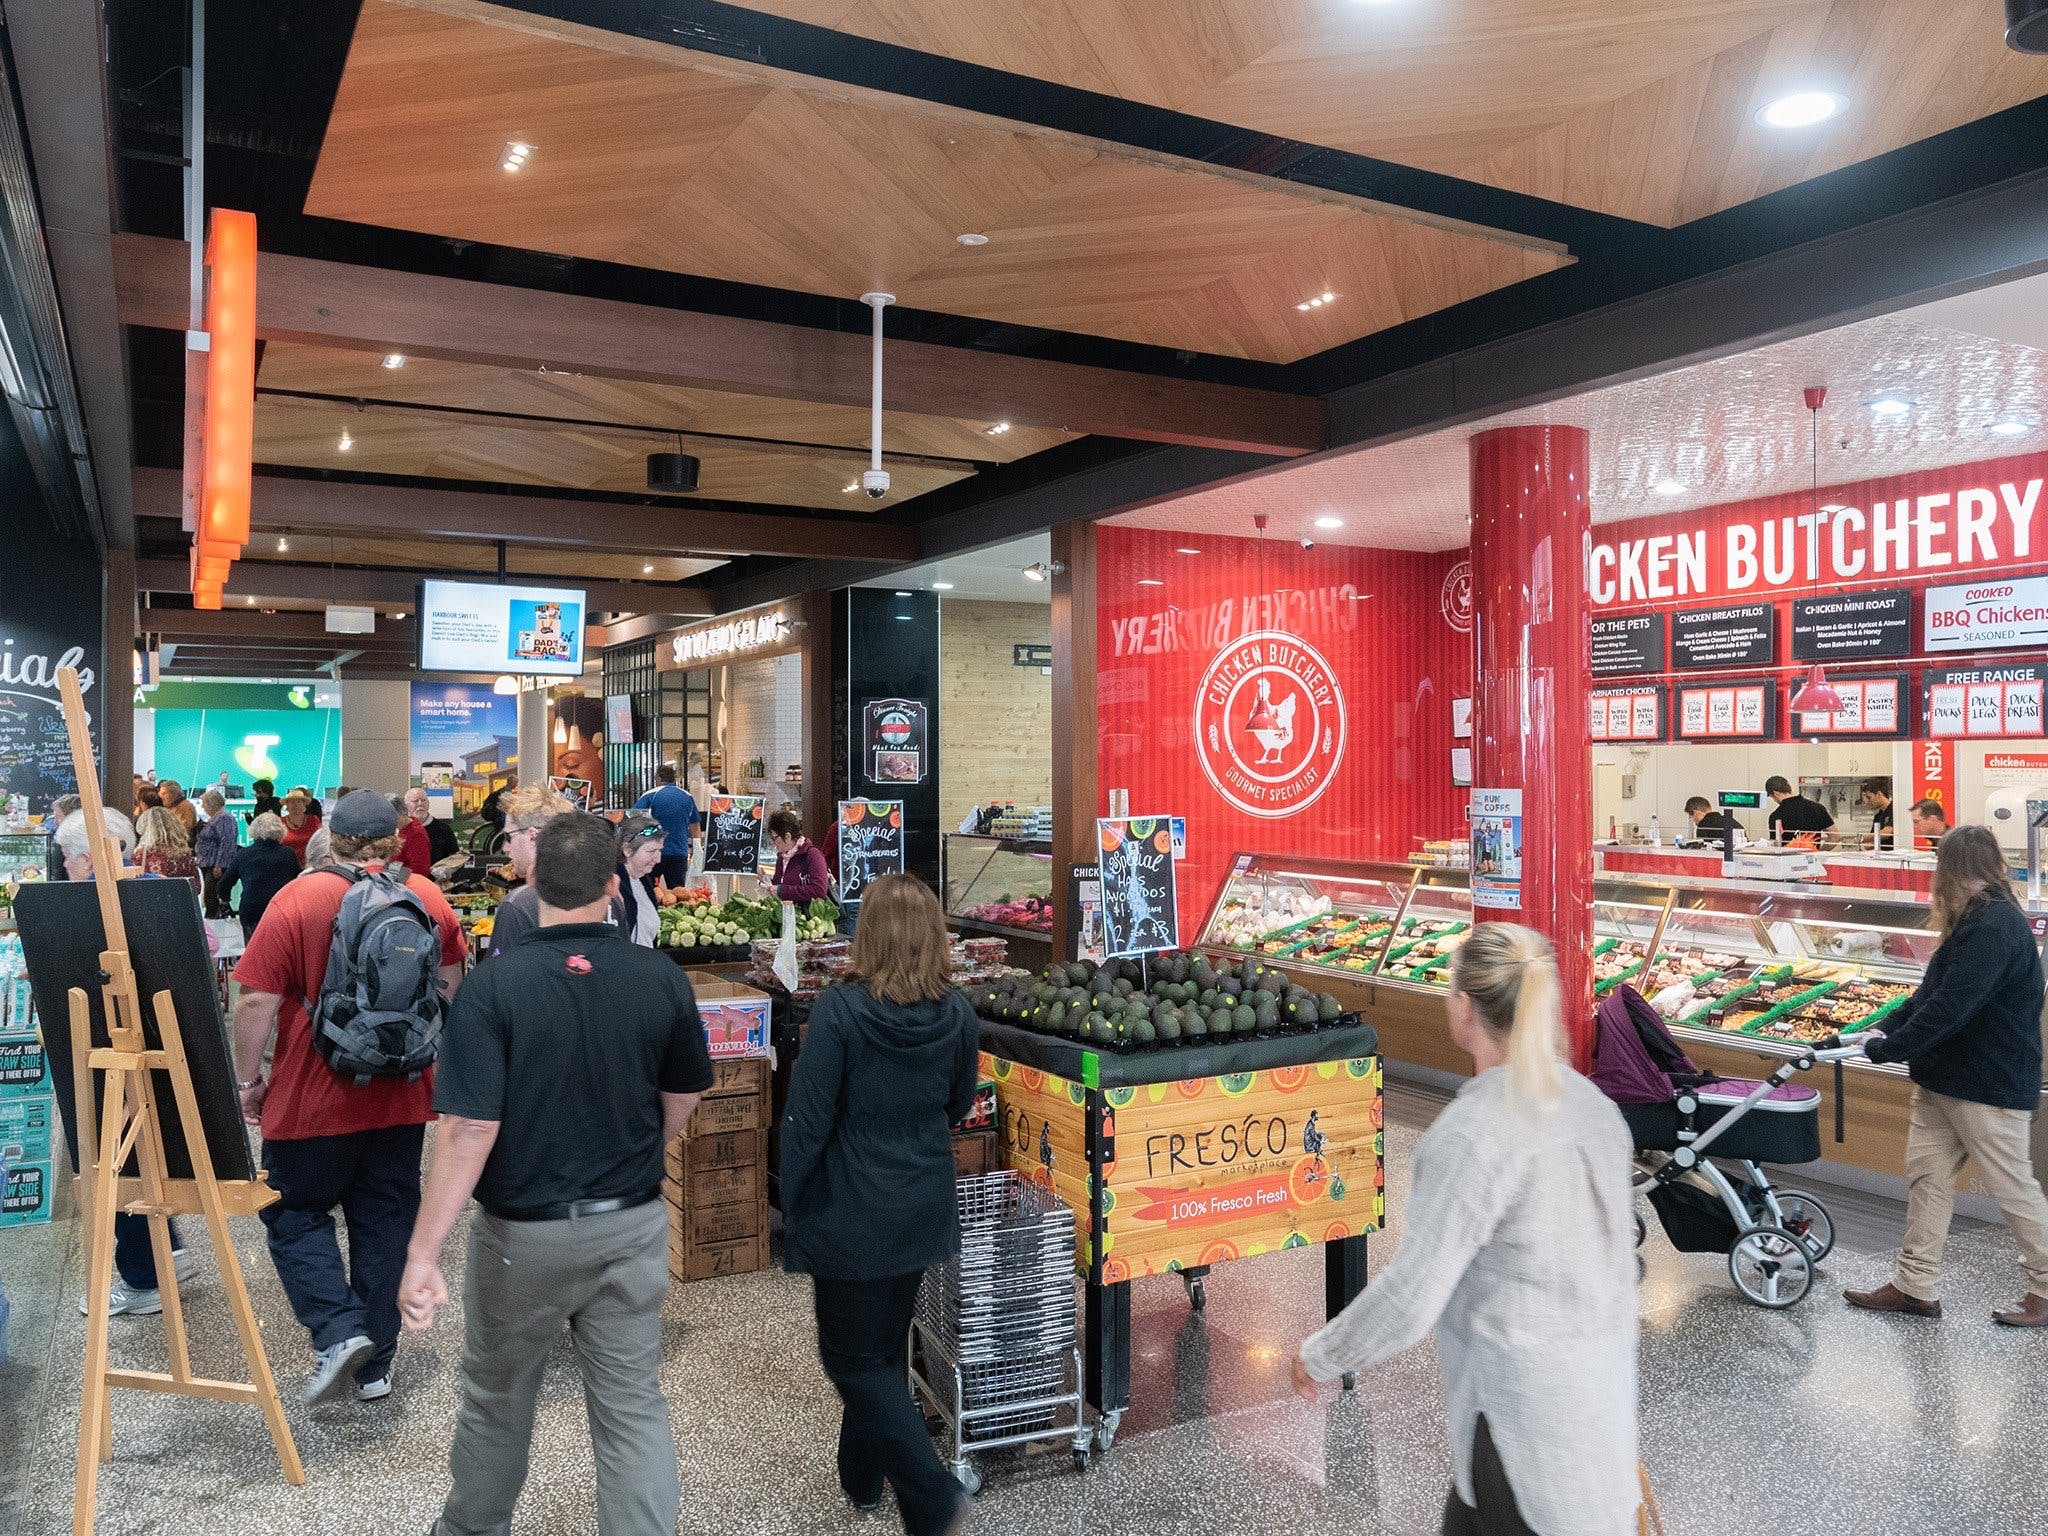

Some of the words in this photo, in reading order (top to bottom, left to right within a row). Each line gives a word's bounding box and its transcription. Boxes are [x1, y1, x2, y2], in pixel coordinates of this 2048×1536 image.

[1726, 479, 2044, 590] BUTCHERY
[1965, 586, 2014, 600] COOKED
[1805, 604, 1842, 615] CHICKEN
[1844, 602, 1864, 611] MINI
[1866, 599, 1896, 610] ROAST
[1679, 613, 1711, 624] CHICKEN
[1712, 609, 1741, 620] BREAST
[1741, 607, 1763, 617] FILOS
[1932, 609, 1971, 628] BBQ
[1607, 620, 1626, 631] THE
[1627, 618, 1650, 630] PETS
[1963, 630, 2015, 642] SEASONED
[534, 646, 556, 655] BAG
[1208, 644, 1262, 705] CHICKEN
[1269, 643, 1333, 706] BUTCHERY
[1946, 671, 1980, 684] FREE
[1983, 669, 2035, 682] RANGE
[1626, 686, 1656, 695] CHICKEN
[420, 700, 443, 708] Make
[444, 701, 460, 709] any
[461, 700, 485, 708] house
[1972, 695, 1998, 707] DUCK
[446, 708, 471, 716] home.
[1989, 755, 2025, 768] chicken
[1225, 766, 1267, 800] GOURMET
[1269, 766, 1319, 801] SPECIALIST
[1484, 795, 1501, 804] RUN
[1484, 803, 1511, 812] COFFS
[714, 812, 757, 831] Special
[848, 822, 897, 845] Special
[706, 842, 719, 863] 2
[1114, 924, 1126, 944] 2
[24, 1044, 41, 1054] YOUR
[21, 1054, 41, 1070] SIDE
[5, 1069, 22, 1079] THERE
[23, 1068, 41, 1078] OFTEN
[1221, 1159, 1288, 1176] marketplace
[22, 1171, 40, 1183] YOUR
[18, 1182, 39, 1197] SIDE
[4, 1197, 20, 1208] THERE
[21, 1195, 39, 1206] OFTEN
[1171, 1201, 1207, 1220] 100%
[1211, 1195, 1253, 1213] Fresco
[1256, 1186, 1288, 1205] Fresh
